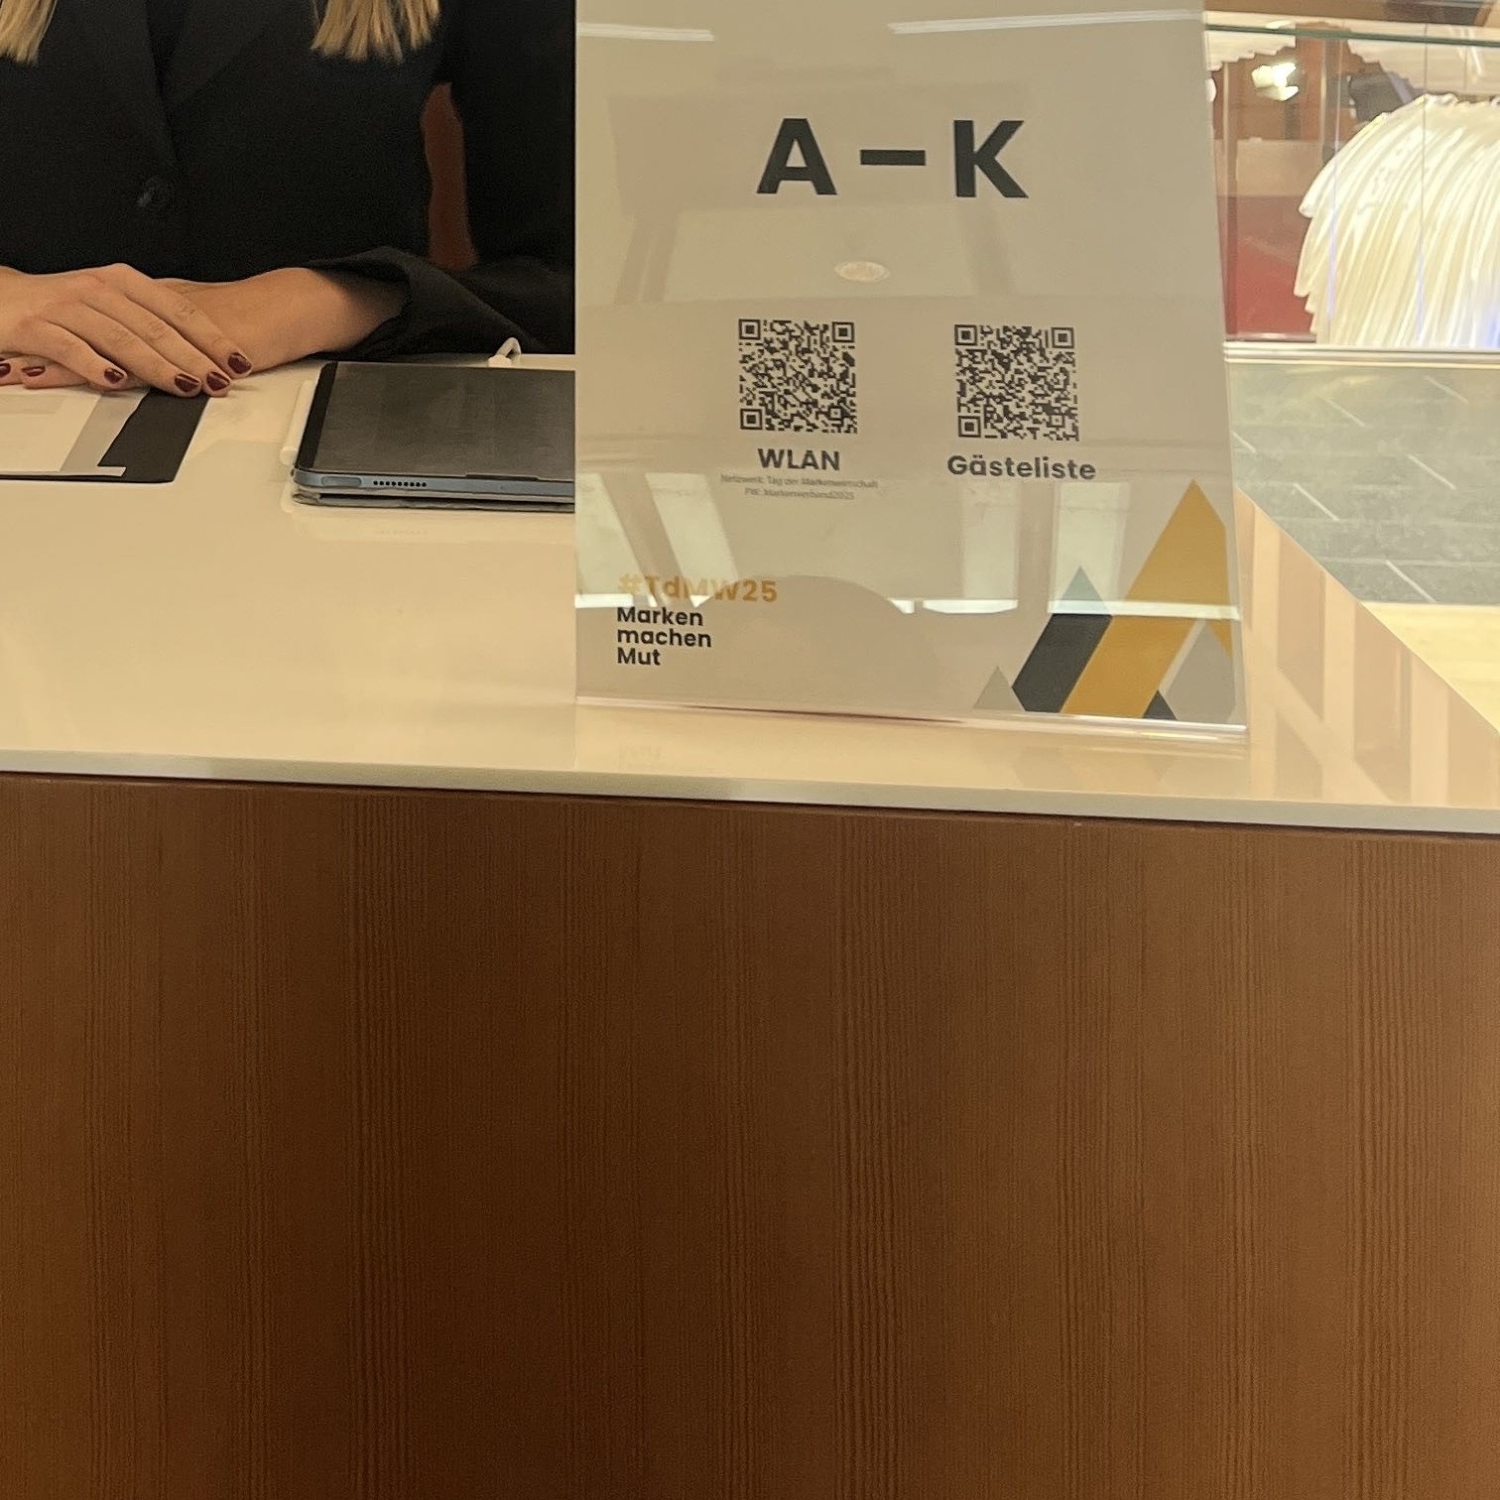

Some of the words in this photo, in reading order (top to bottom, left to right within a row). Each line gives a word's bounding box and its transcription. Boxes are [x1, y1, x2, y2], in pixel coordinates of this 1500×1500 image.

[757, 448, 841, 471] WLAN
[947, 454, 1096, 480] Gästeliste
[617, 606, 704, 627] Marken
[617, 628, 712, 648] machen
[617, 647, 661, 666] Mut
